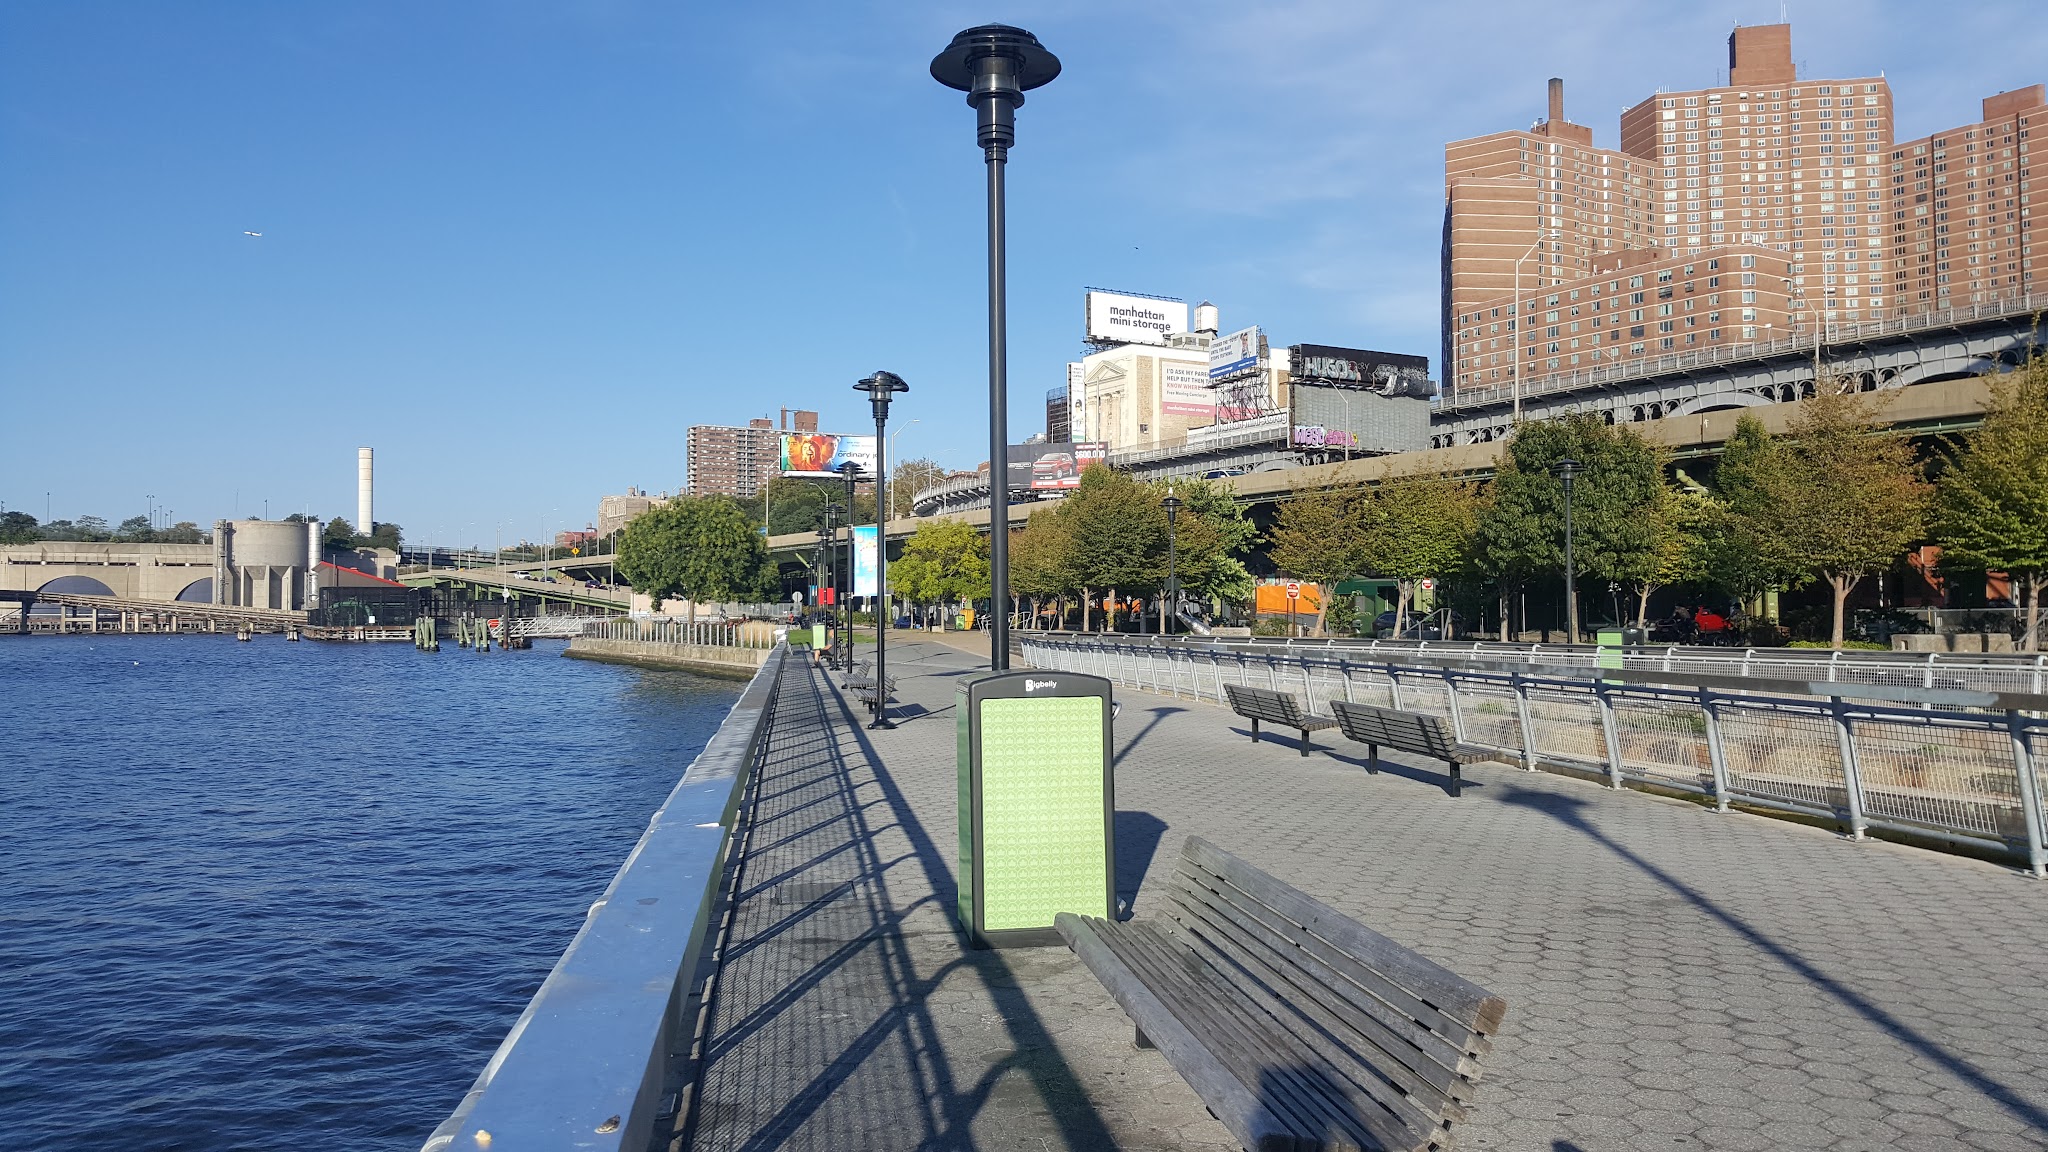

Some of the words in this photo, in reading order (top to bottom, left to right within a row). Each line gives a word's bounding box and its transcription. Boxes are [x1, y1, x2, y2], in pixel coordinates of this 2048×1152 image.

[1110, 305, 1165, 321] manhattan
[1110, 316, 1131, 326] mini
[1133, 320, 1171, 333] storage
[1260, 412, 1287, 426] storag
[838, 451, 870, 459] ordinary
[1025, 679, 1057, 691] Bigbelly
